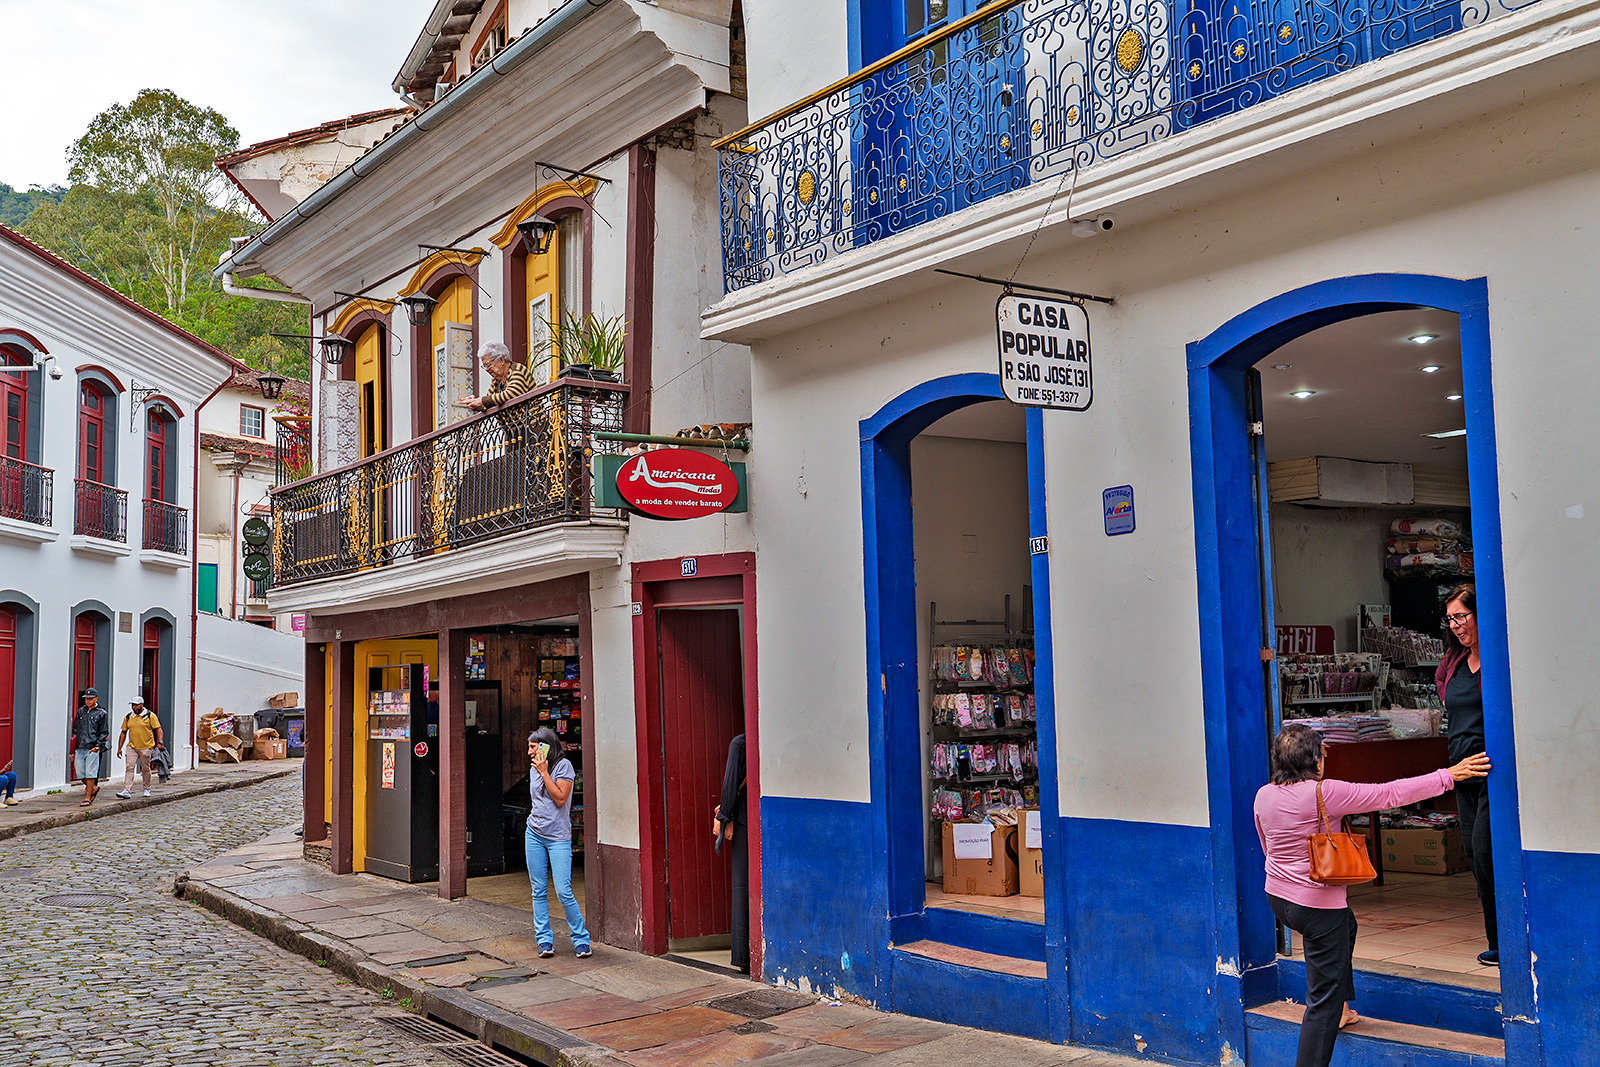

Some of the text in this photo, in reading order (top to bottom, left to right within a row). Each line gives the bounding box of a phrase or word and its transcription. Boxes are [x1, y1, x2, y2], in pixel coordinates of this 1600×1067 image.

[1018, 302, 1070, 330] CASA
[1002, 330, 1087, 363] POPULAR
[629, 456, 716, 482] Americana
[641, 498, 662, 506] moda
[663, 498, 673, 506] de
[674, 499, 698, 507] vender
[699, 500, 723, 508] barato
[1031, 538, 1046, 553] 131
[1275, 626, 1316, 653] TriFil
